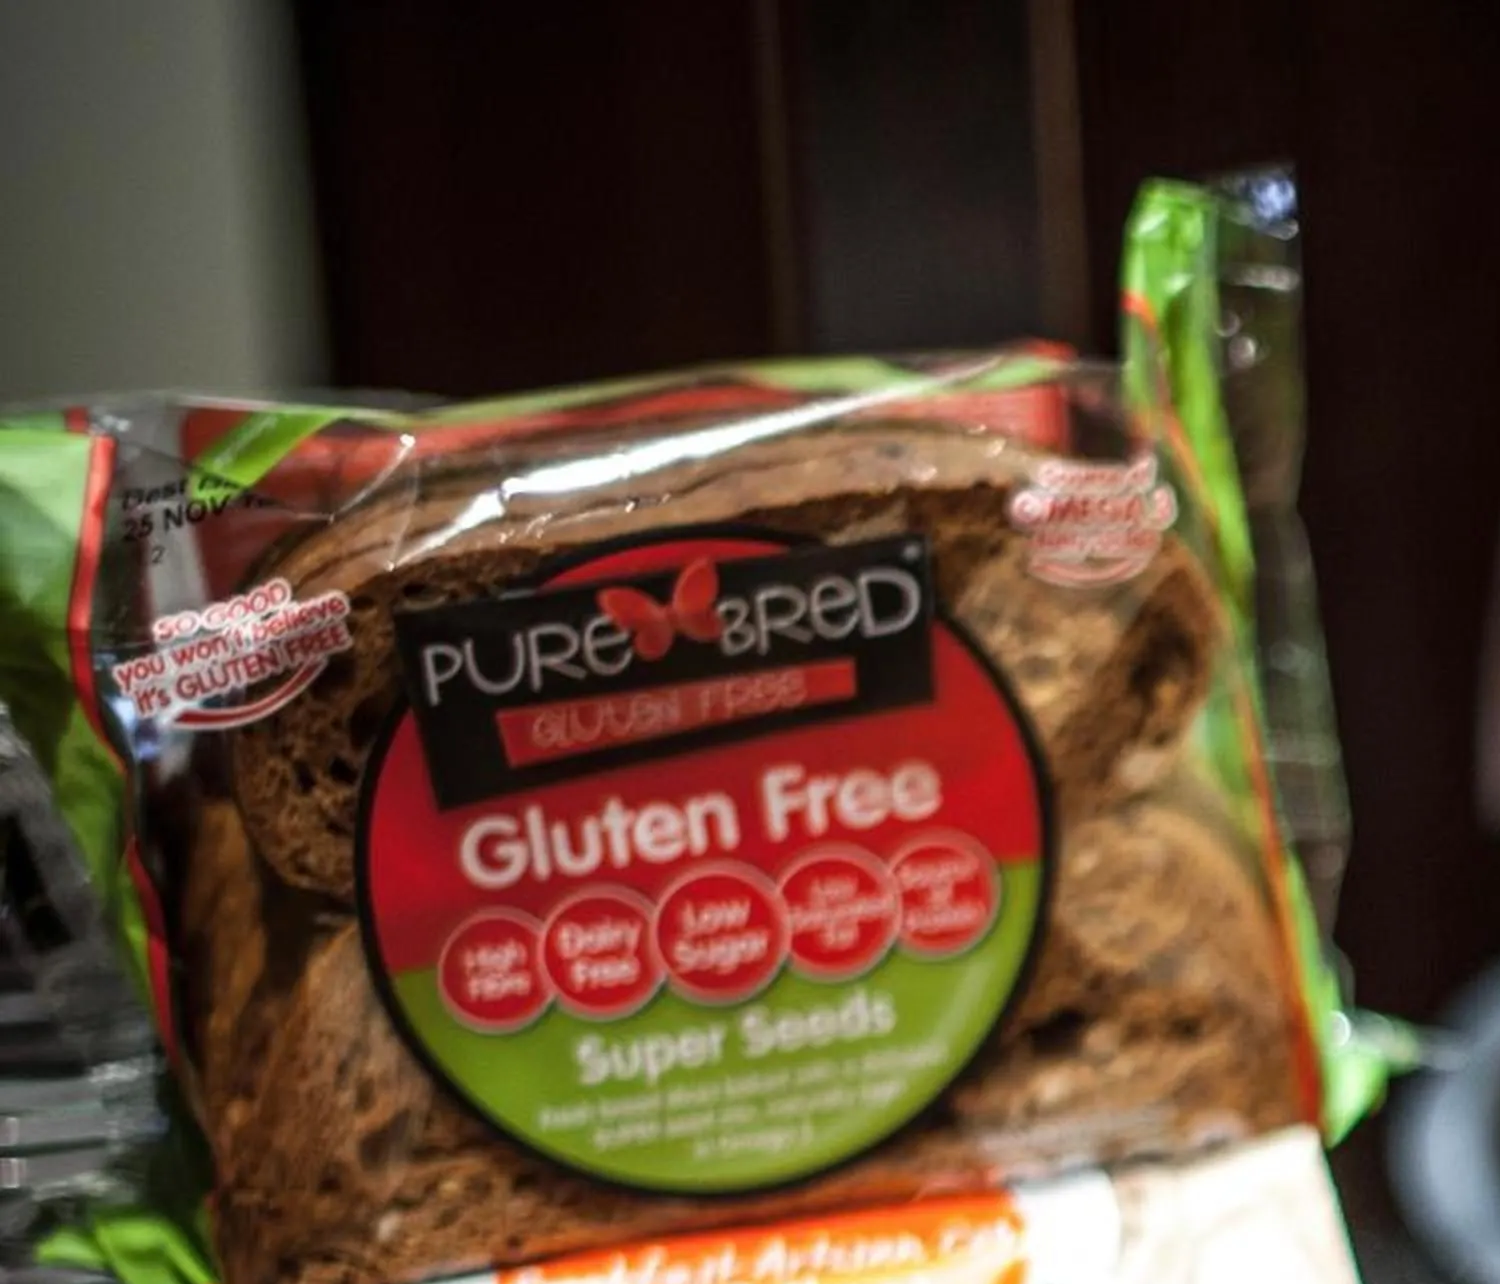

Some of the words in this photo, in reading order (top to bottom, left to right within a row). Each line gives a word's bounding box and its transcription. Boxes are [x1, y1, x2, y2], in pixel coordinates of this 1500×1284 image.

[124, 519, 154, 541] 25
[164, 495, 231, 532] NOV
[155, 613, 198, 641] SO
[203, 579, 290, 628] GOOD
[172, 630, 245, 667] won't
[251, 597, 348, 642] believe
[422, 612, 634, 706] PURE
[717, 566, 922, 657] BRED
[175, 651, 280, 701] GLUTEN
[287, 626, 348, 663] FREE
[460, 793, 740, 889] Gluten
[762, 760, 942, 842] Free
[558, 918, 642, 960] Dairy
[682, 899, 751, 937] Low
[673, 927, 769, 976] Sugar
[575, 1023, 726, 1086] Super
[740, 989, 897, 1058] Seeds
